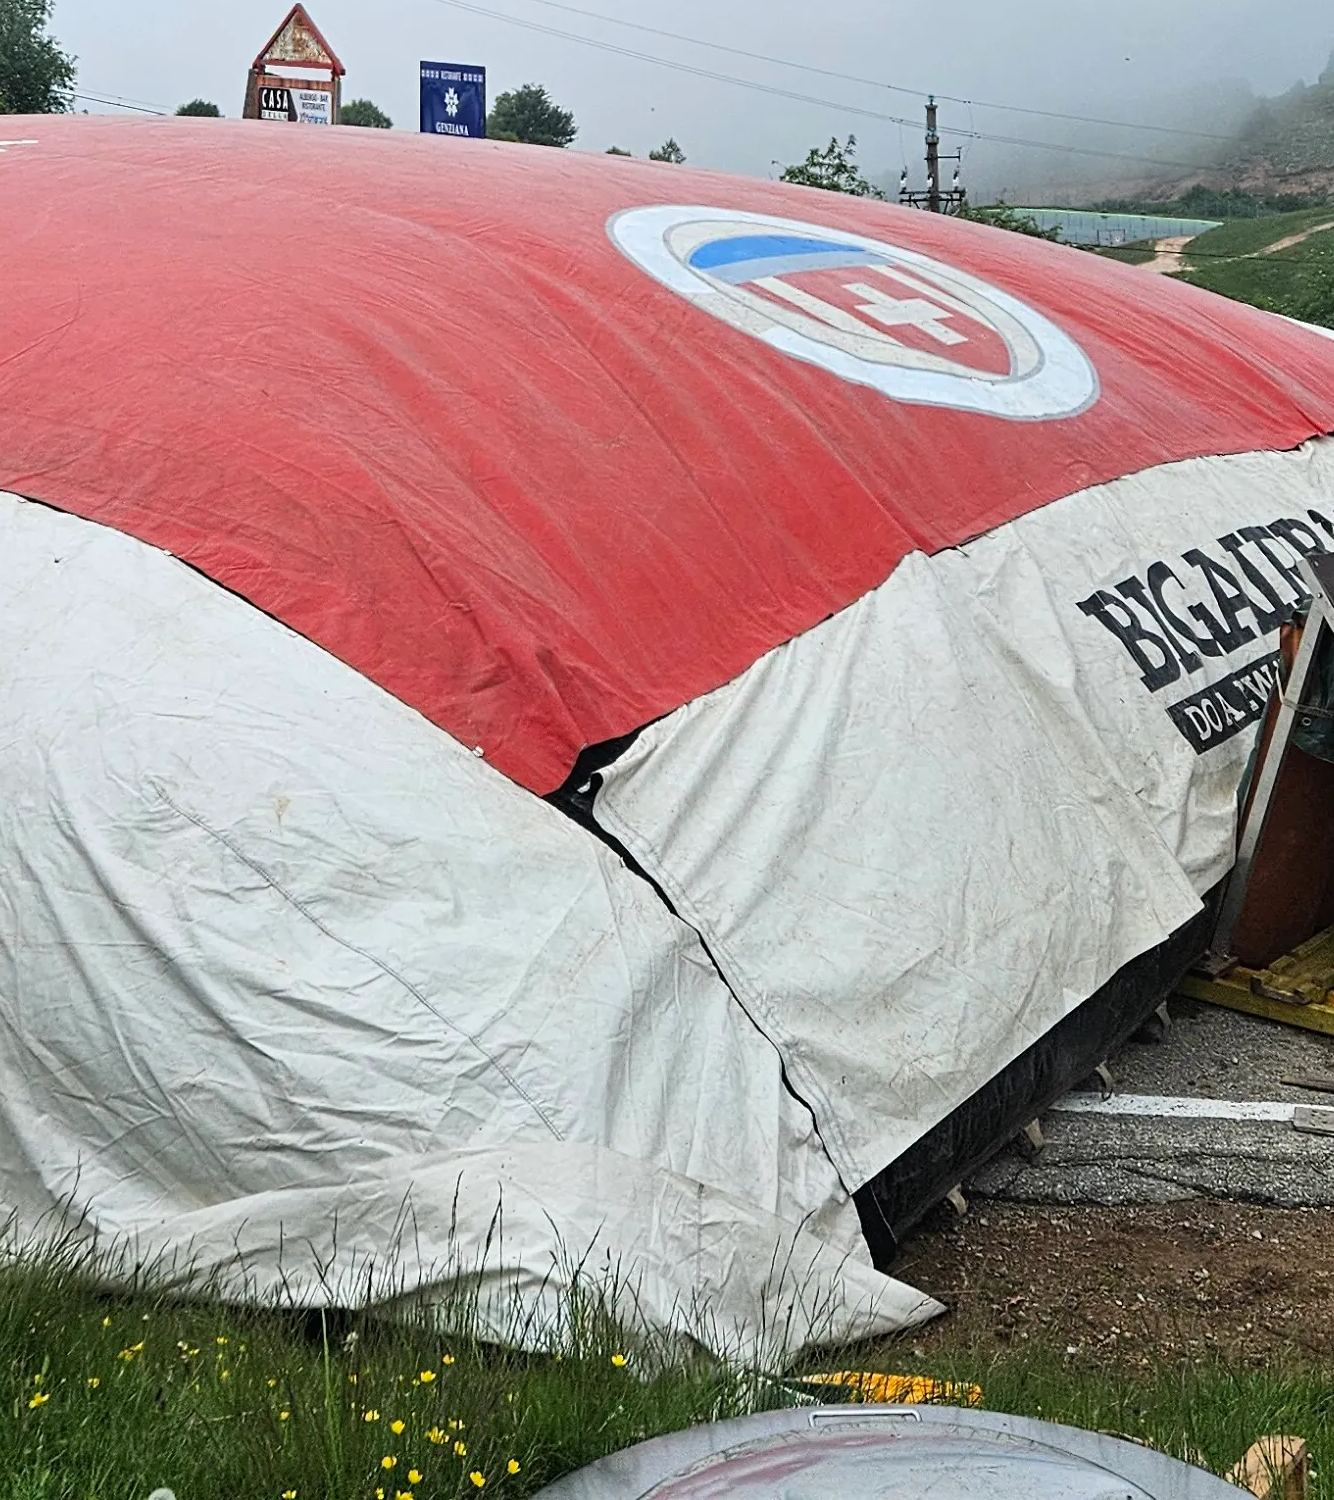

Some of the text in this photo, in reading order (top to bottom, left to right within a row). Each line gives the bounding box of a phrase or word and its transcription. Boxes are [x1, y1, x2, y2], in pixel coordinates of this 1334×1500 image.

[261, 88, 289, 109] CASA
[262, 111, 287, 119] DELLA
[435, 121, 470, 136] GENZIANA
